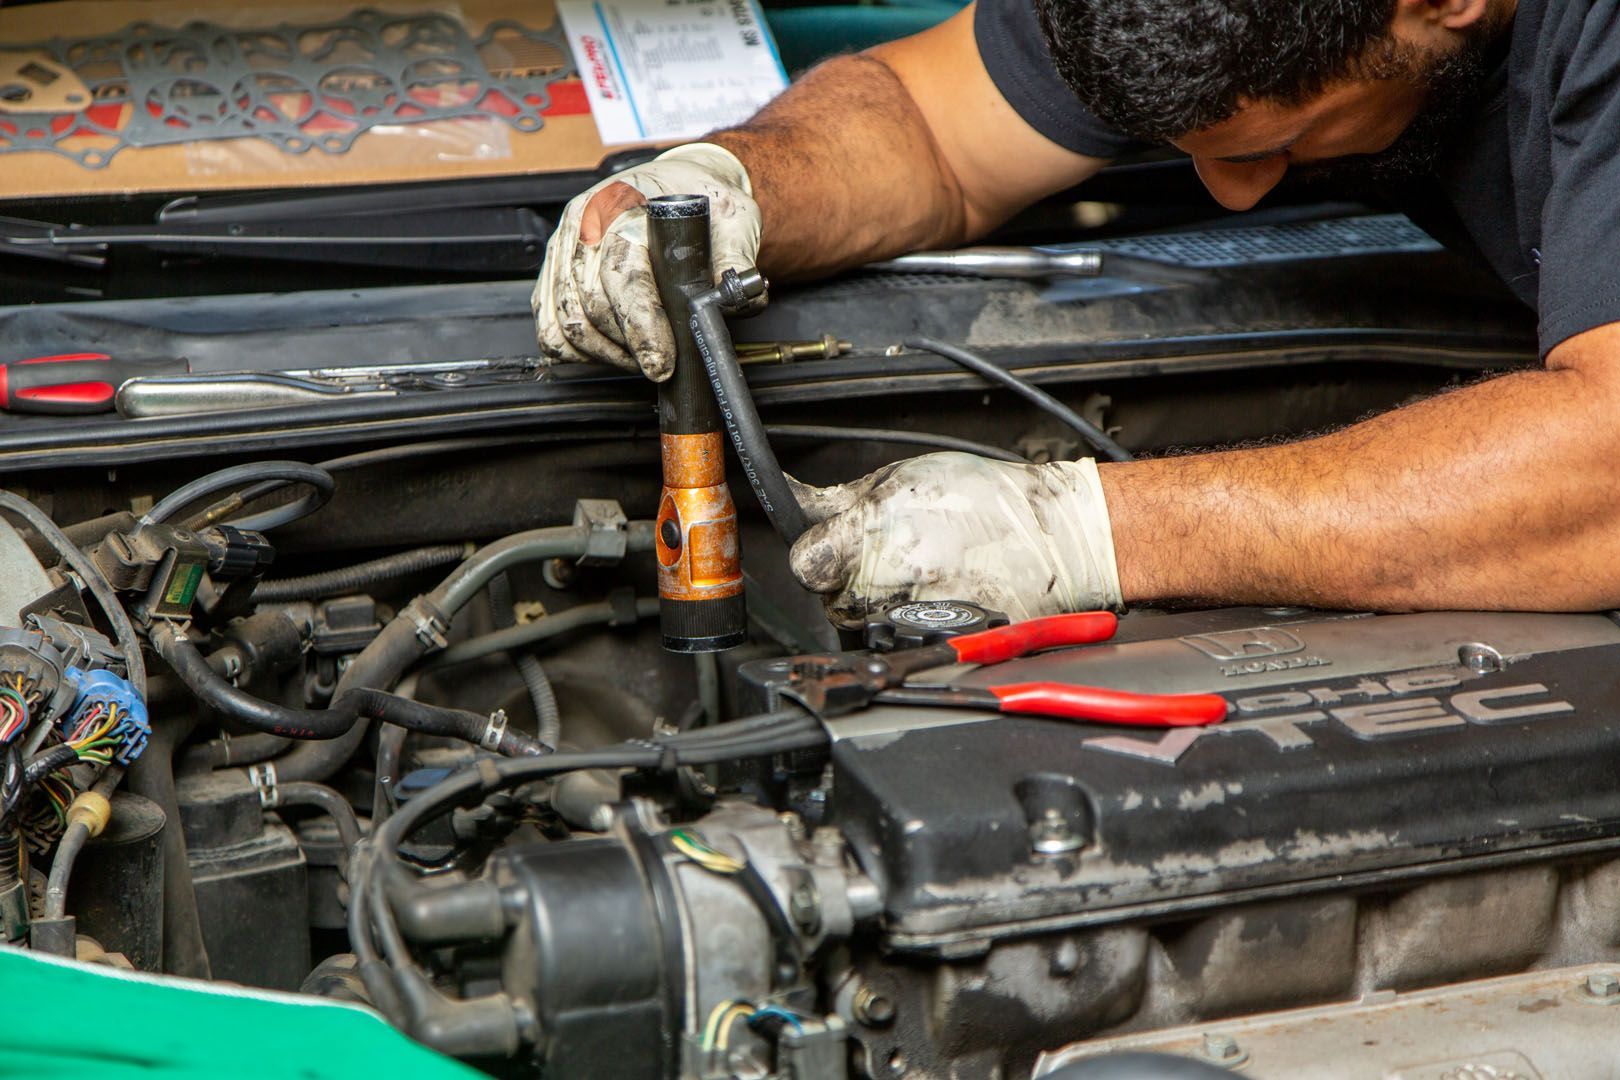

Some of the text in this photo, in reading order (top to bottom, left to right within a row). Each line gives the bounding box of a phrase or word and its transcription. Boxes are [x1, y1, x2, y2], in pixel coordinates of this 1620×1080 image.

[694, 330, 718, 377] Injection
[712, 378, 728, 405] Fuel
[723, 407, 736, 428] For
[732, 430, 746, 453] Not
[1219, 655, 1333, 677] HONDA
[1227, 672, 1462, 713] OHC
[1081, 683, 1576, 767] VTEC
